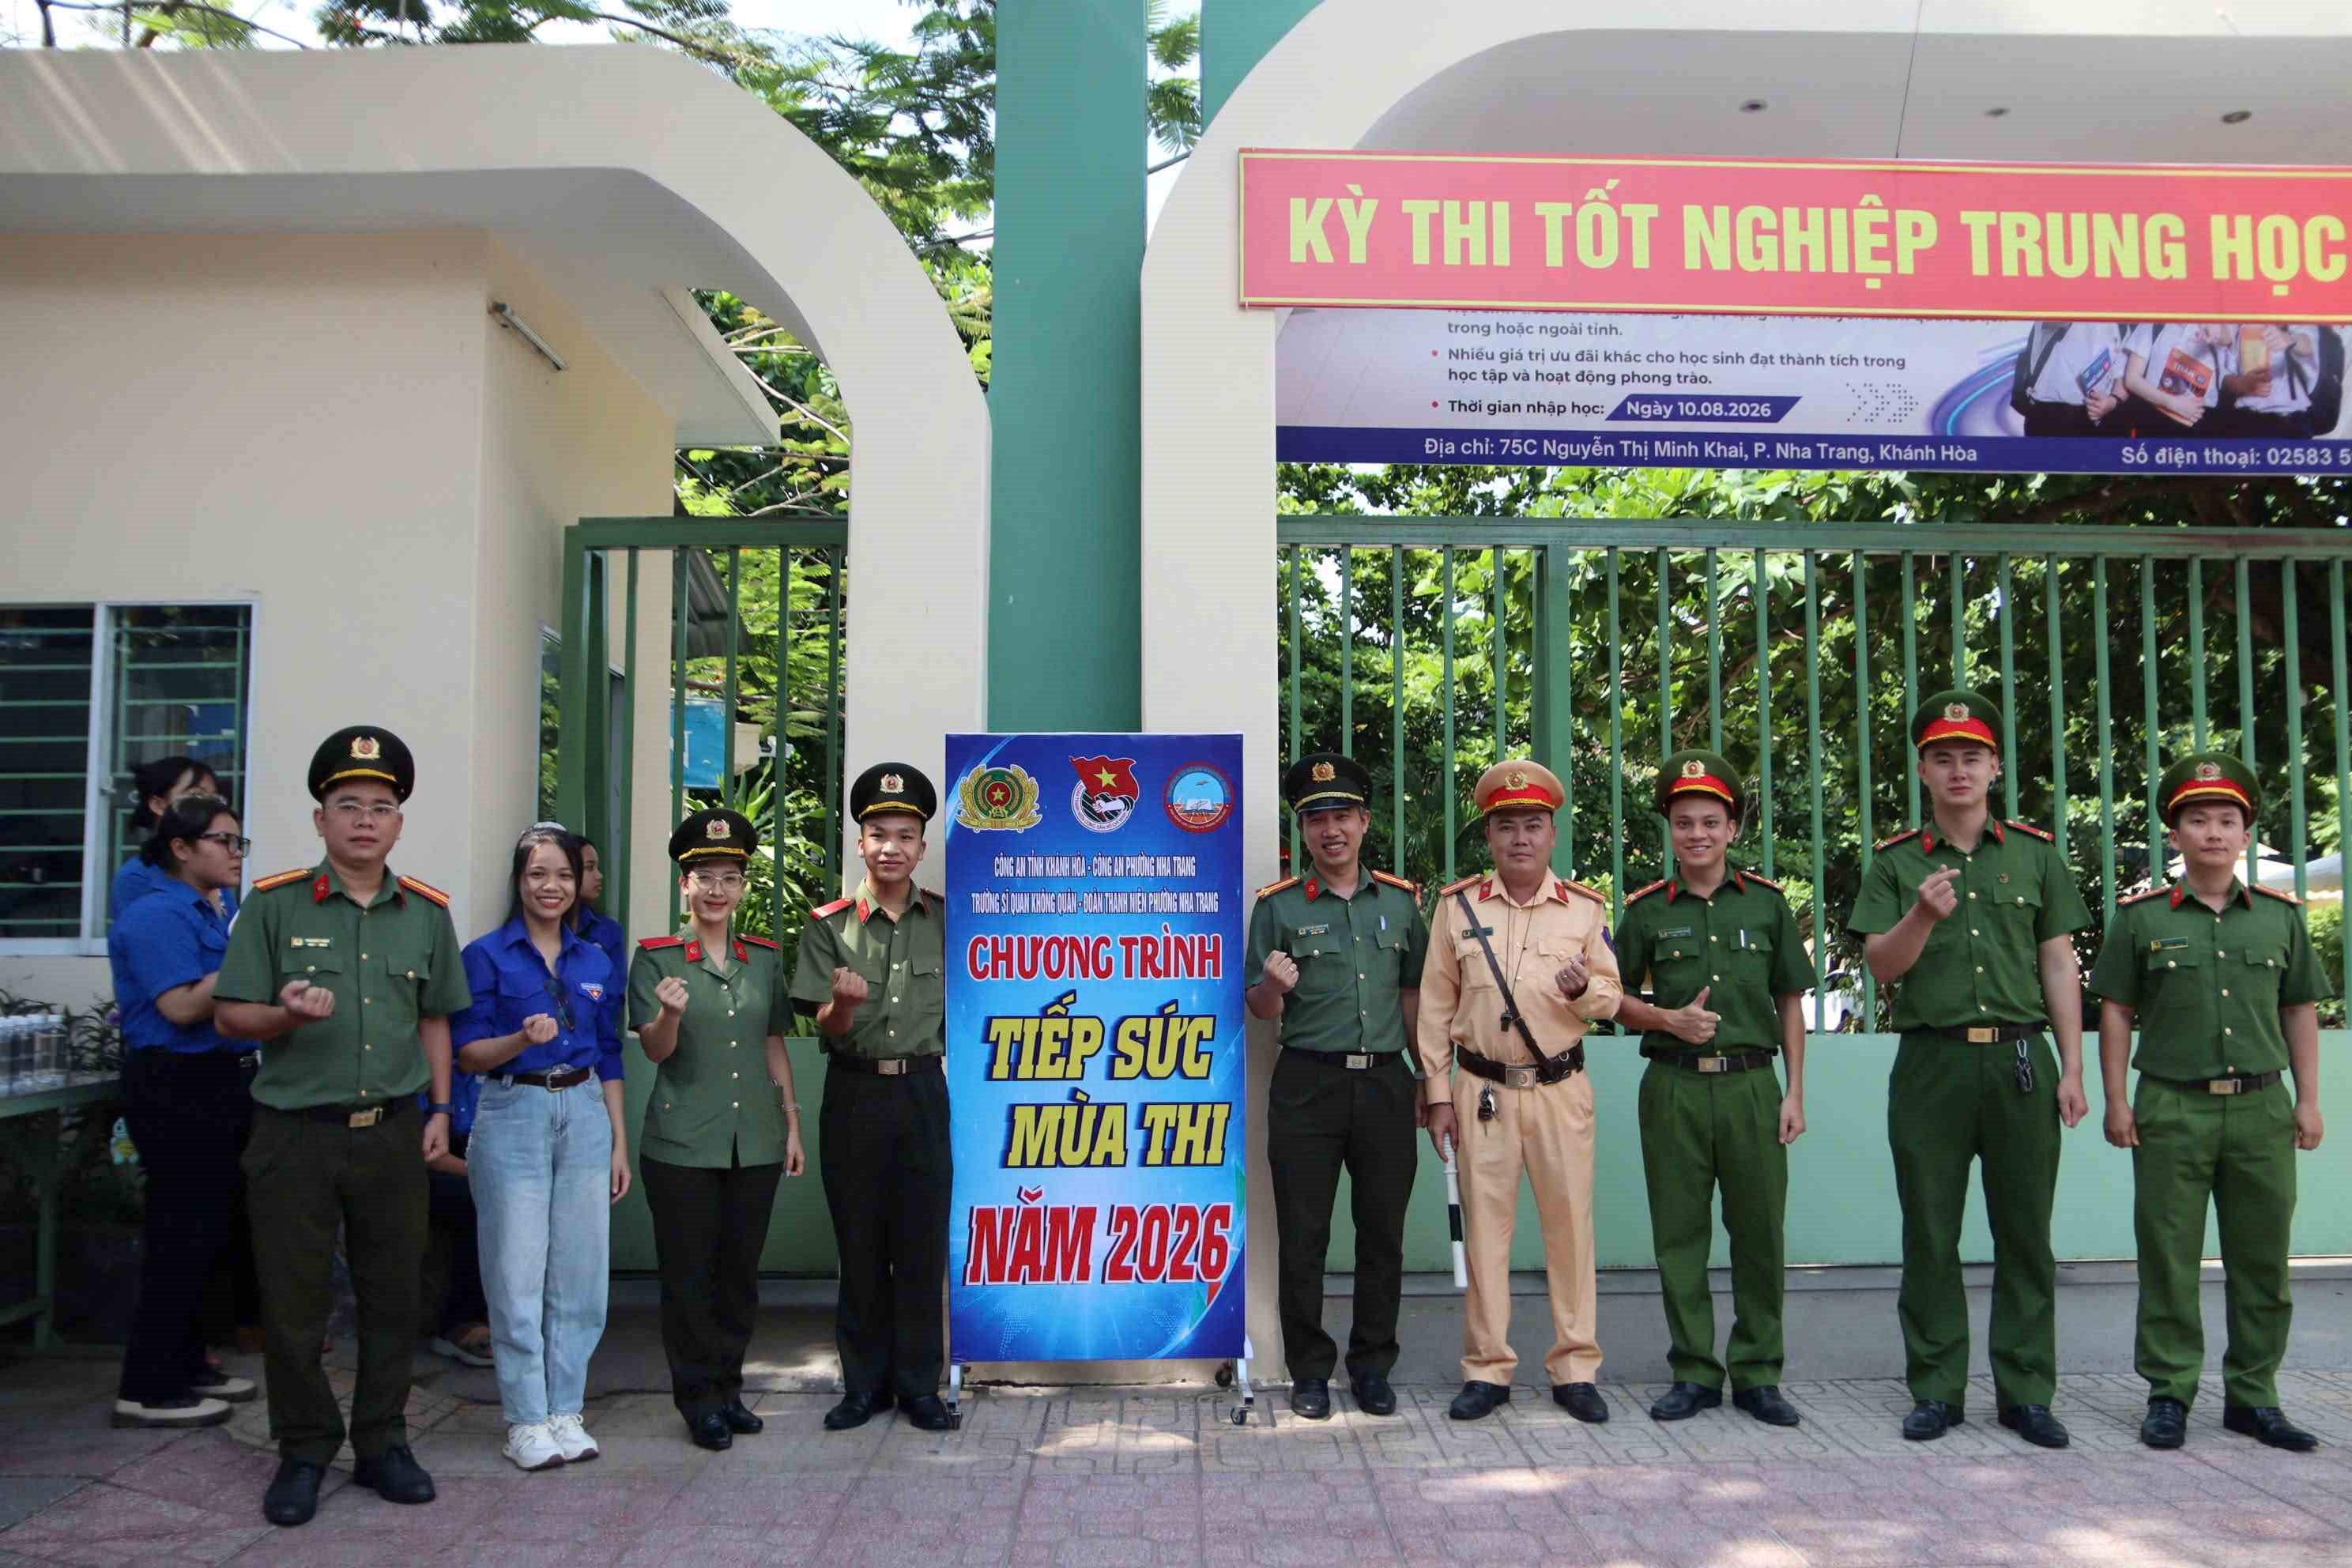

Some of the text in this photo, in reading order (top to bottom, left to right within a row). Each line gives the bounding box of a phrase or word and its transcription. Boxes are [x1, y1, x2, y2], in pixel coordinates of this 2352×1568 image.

[1289, 179, 2347, 296] KỲ THI TỐT NGHIỆP TRUNG HỌC
[1448, 322, 1623, 337] trong hoặc ngoài tỉnh.
[1499, 349, 1523, 364] giá
[1528, 349, 1545, 365] trị
[1551, 352, 1570, 362] ưu
[1575, 350, 1599, 363] đãi
[1604, 349, 1642, 364] khác
[1646, 351, 1675, 364] cho
[1680, 352, 1709, 367] học
[1713, 352, 1745, 364] sinh
[1750, 352, 1775, 368] đạt
[1780, 354, 1826, 366] thành
[1830, 354, 1859, 368] tích
[1864, 356, 1906, 369] trong
[1448, 368, 1713, 386] học tập và hoạt động phong trào.
[1448, 400, 1772, 419] Thời gian nhập học: Ngày 10.08.2026
[1425, 436, 1977, 463] Địa chỉ: 75C Nguyễn Thị Minh Khai, P. Nha Trang, Khánh Hòa
[2121, 443, 2148, 465] Số
[2154, 447, 2198, 468] điện
[2203, 447, 2261, 469] thoại:
[2267, 447, 2331, 466] 02583
[994, 851, 1014, 877] CÔNG
[1016, 856, 1026, 877] AN
[1027, 849, 1043, 877] TỈNH
[1046, 851, 1070, 877] KHÁNH
[1072, 851, 1086, 877] HÒA
[1093, 852, 1112, 877] CÔNG
[1114, 856, 1124, 877] AN
[1125, 851, 1155, 877] PHƯỜNG
[1156, 856, 1171, 877] NHA
[1173, 856, 1196, 877] TRANG
[971, 888, 1000, 913] TRƯỜNG
[1001, 889, 1009, 913] SĨ
[1011, 892, 1030, 914] QUAN
[1031, 888, 1056, 913] KHÔNG
[1057, 888, 1077, 914] QUÂN
[1084, 888, 1103, 913] ĐOÀN
[1105, 892, 1128, 913] THANH
[1129, 888, 1147, 913] NIÊN
[1148, 888, 1178, 913] PHƯỜNG
[1179, 892, 1194, 913] NHA
[1196, 892, 1219, 913] TRANG
[968, 923, 1222, 980] CHƯƠNG TRÌNH
[983, 989, 1216, 1080] TIẾP SỨC
[1002, 1088, 1231, 1167] MÙA THI
[964, 1186, 1231, 1285] NĂM 2026
